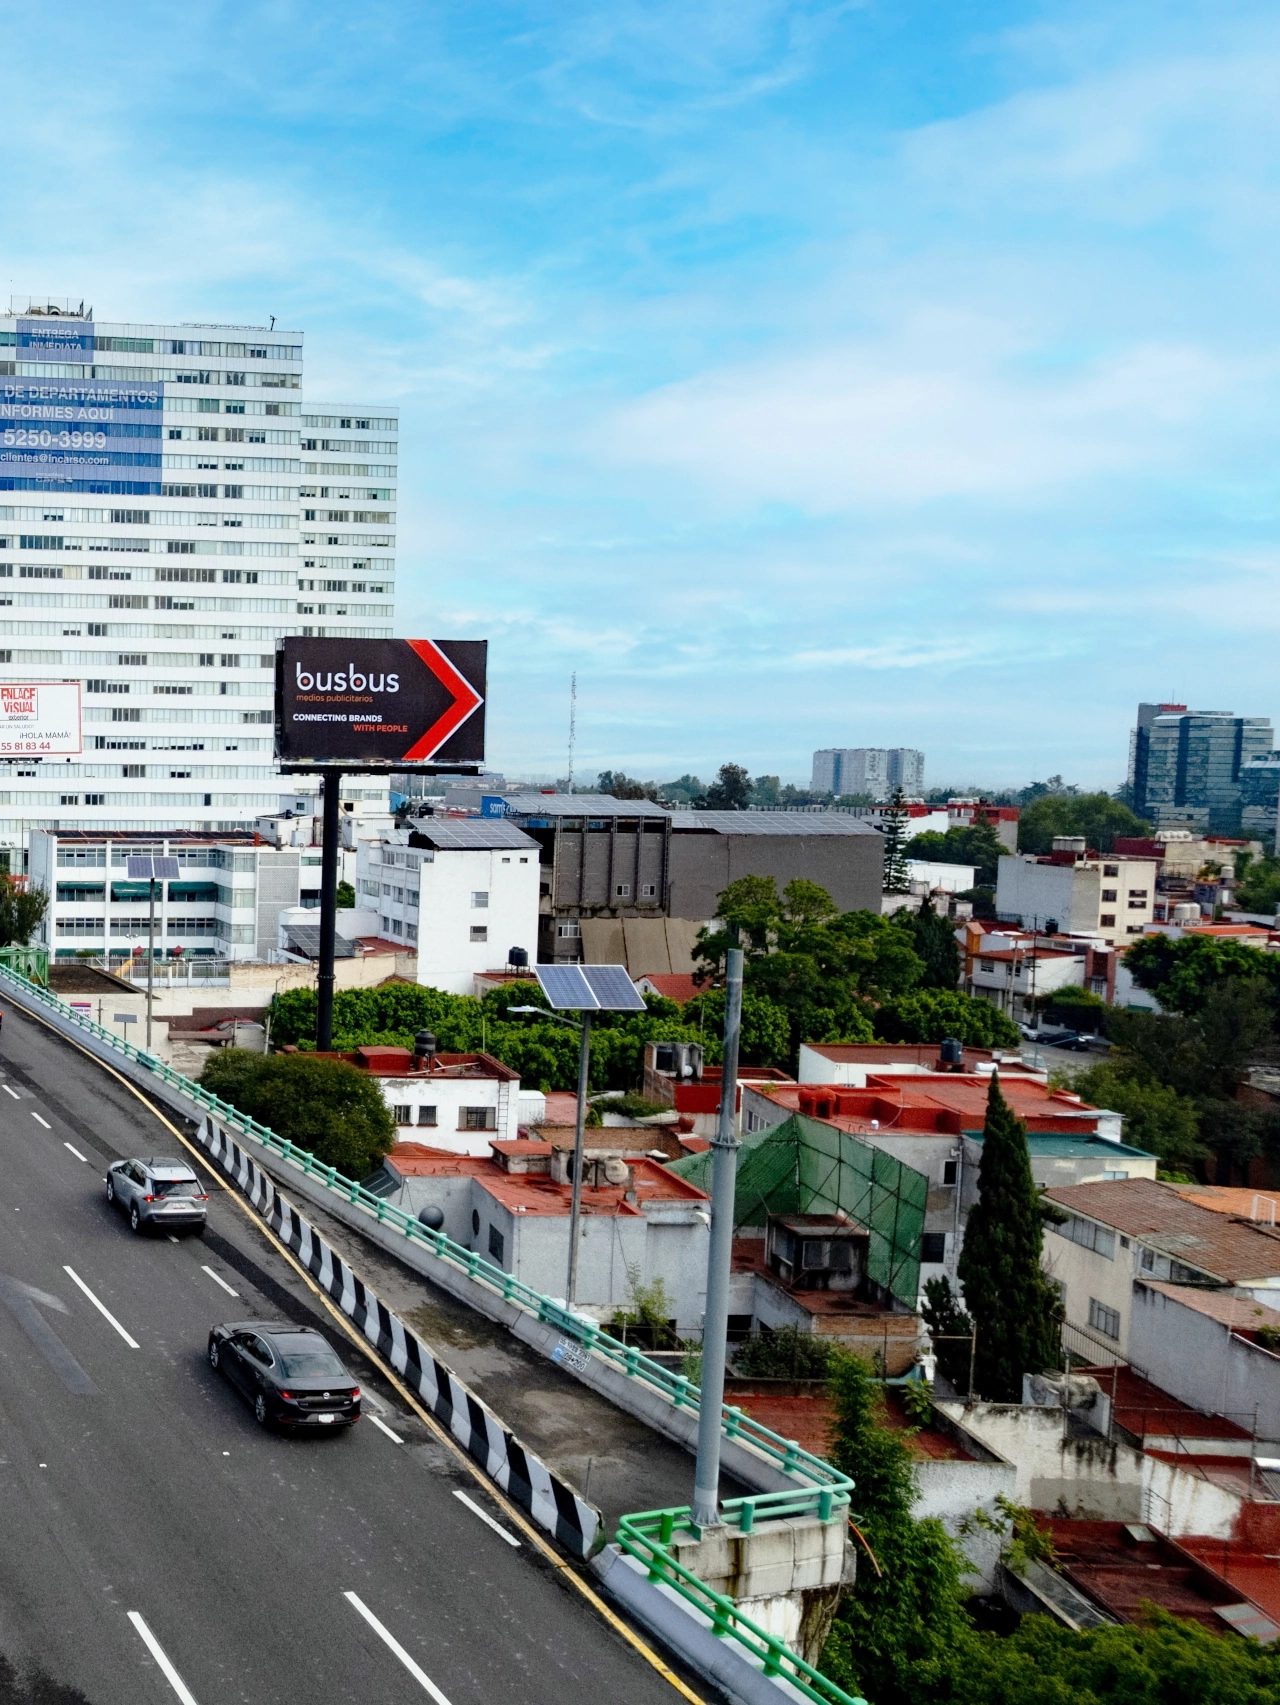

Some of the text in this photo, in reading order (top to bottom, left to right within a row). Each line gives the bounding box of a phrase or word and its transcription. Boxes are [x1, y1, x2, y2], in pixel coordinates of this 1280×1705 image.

[31, 328, 79, 339] ENTREGA
[29, 341, 82, 351] INMEDIATA
[4, 385, 24, 398] DE
[28, 386, 158, 404] DEPARTAMENTOS
[77, 405, 114, 420] AQUÍ
[3, 428, 107, 449] 5250-3999
[0, 452, 109, 466] clientes@incarso.com
[296, 662, 400, 693] busbus
[296, 694, 374, 703] medios publicitarios
[292, 713, 383, 723] CONNECTING BRANDS
[353, 723, 408, 733] WITH PEOPLE
[1, 742, 12, 751] 55
[14, 742, 23, 750] 81
[25, 742, 37, 750] 83
[39, 741, 51, 750] 44
